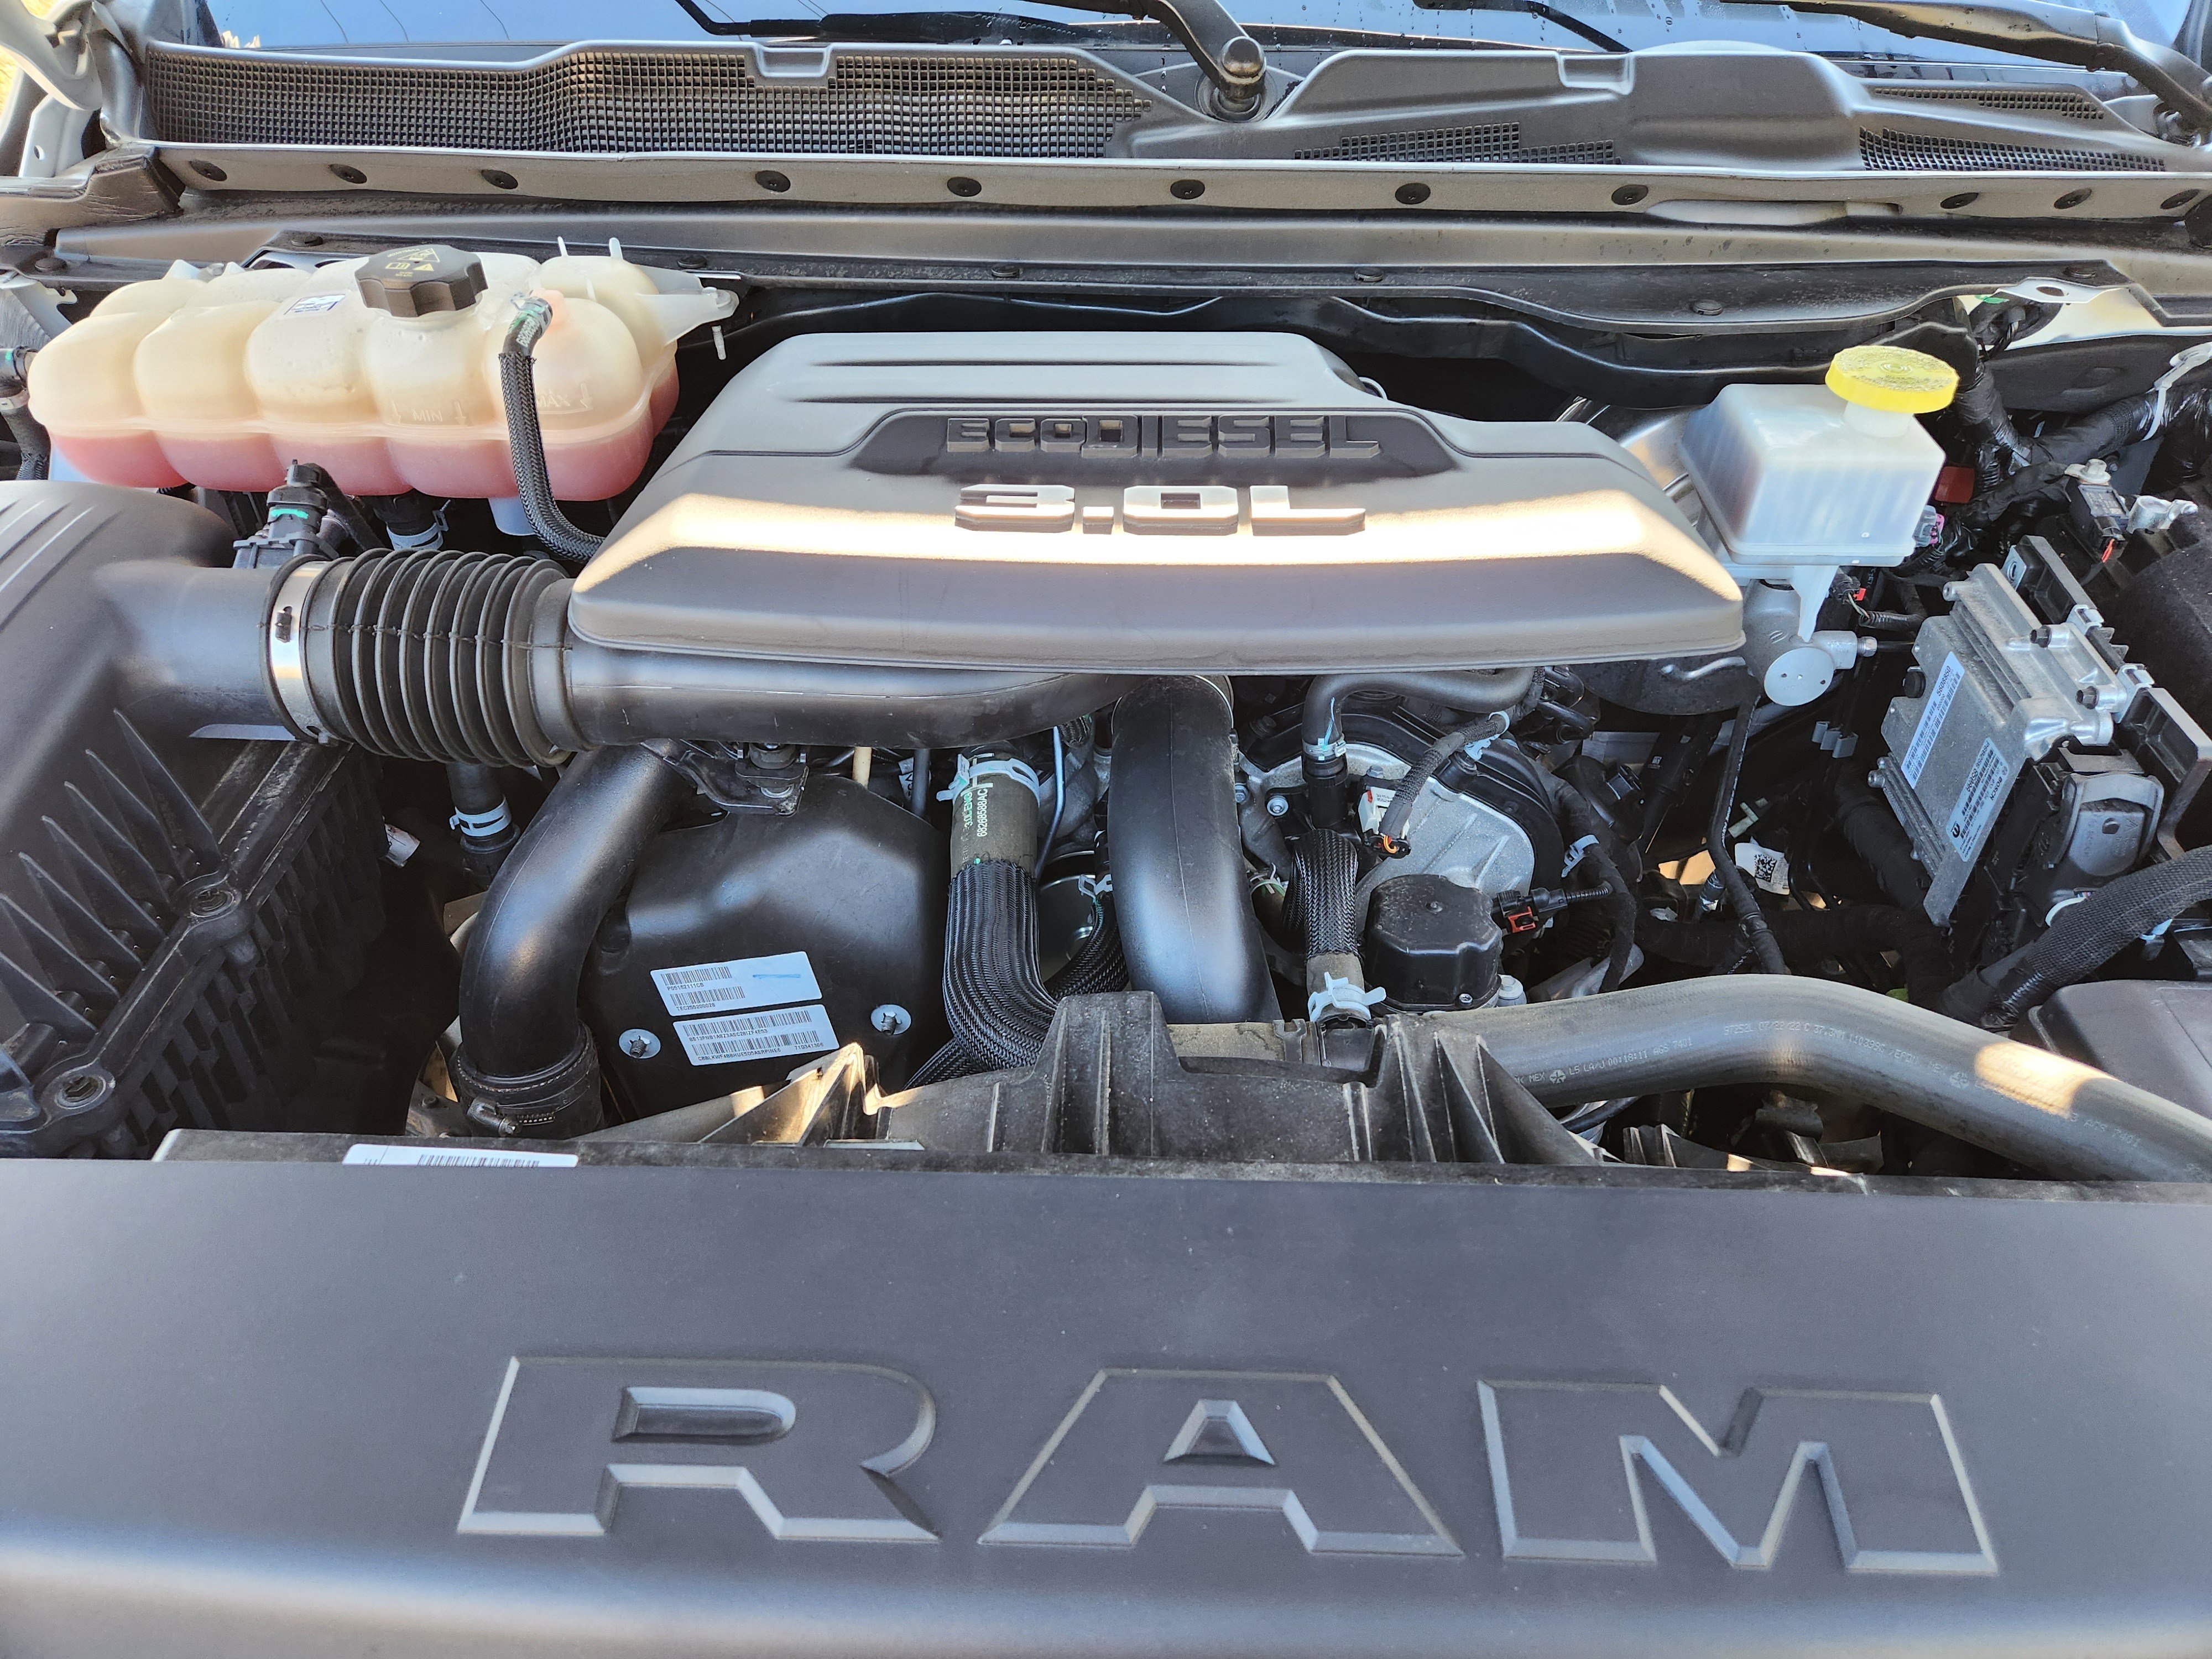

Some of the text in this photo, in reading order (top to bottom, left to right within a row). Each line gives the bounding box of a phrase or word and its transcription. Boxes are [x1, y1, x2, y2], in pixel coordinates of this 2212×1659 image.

[536, 393, 570, 408] MAX
[412, 409, 442, 422] MIN
[954, 484, 1366, 536] 3.0L
[1990, 776, 2002, 801] BOSCH
[977, 788, 988, 837] 68268588AC
[1529, 1071, 1546, 1083] MEX
[457, 1356, 2000, 1575] RAM
